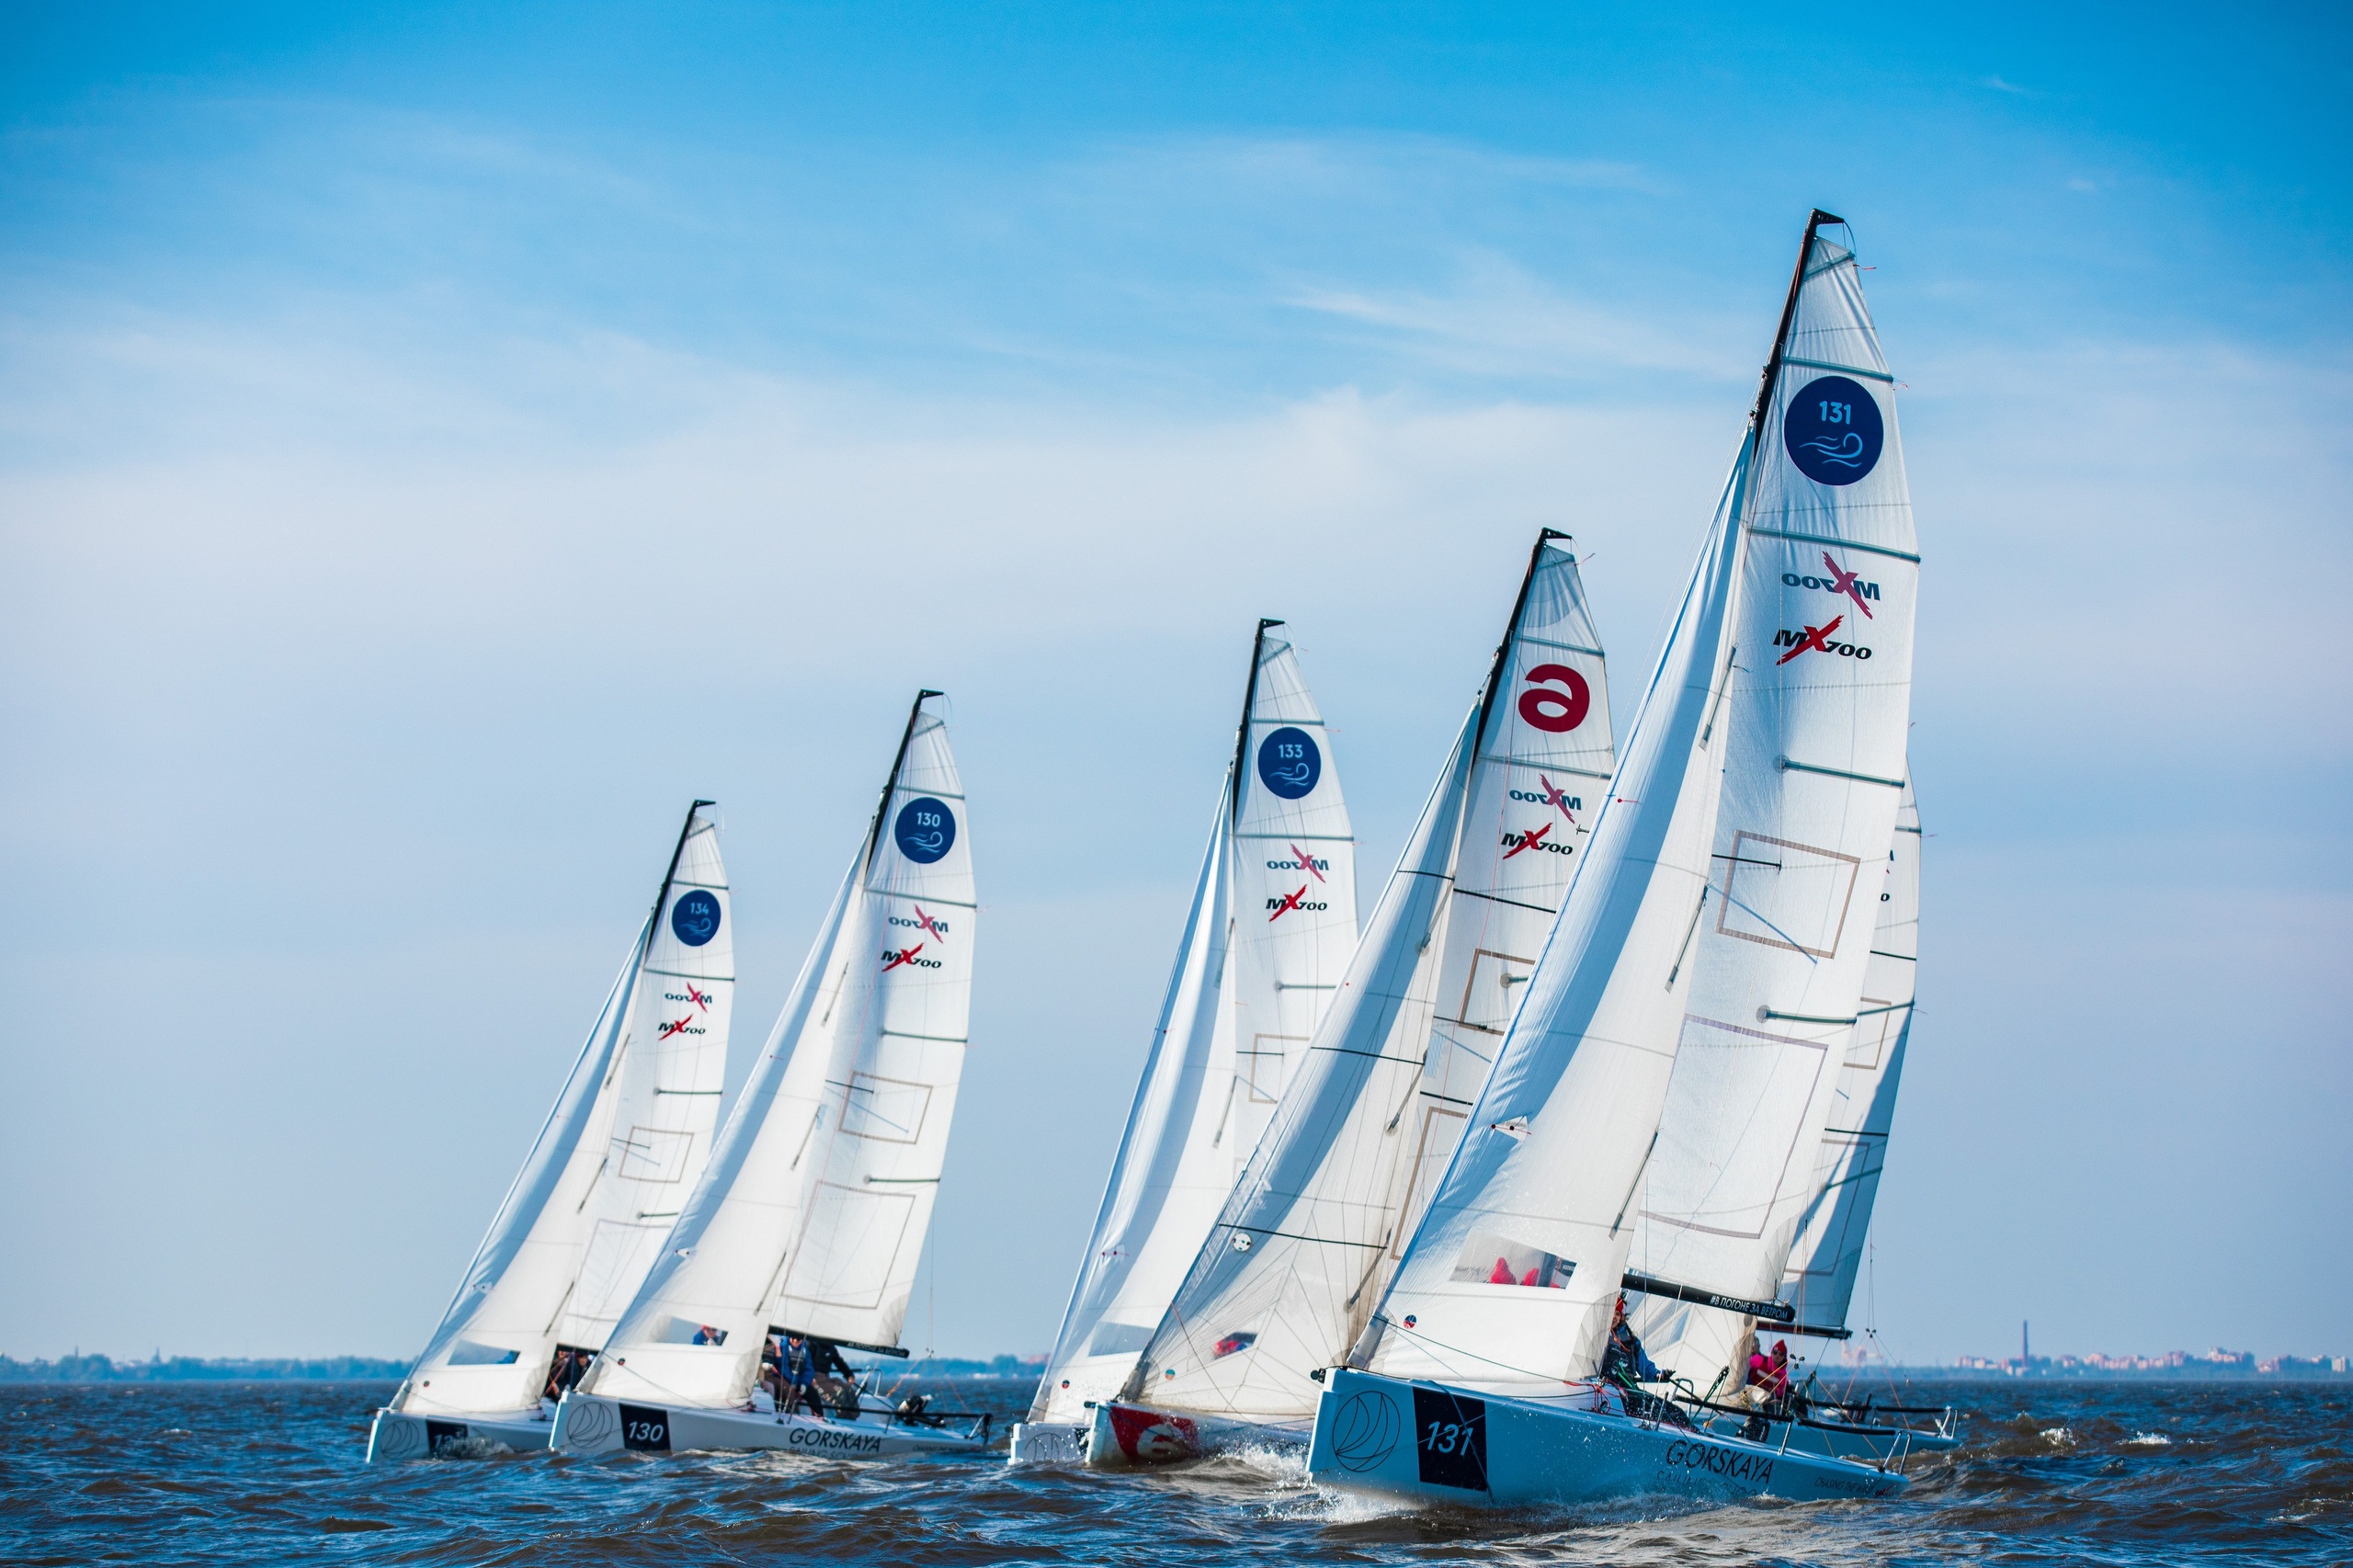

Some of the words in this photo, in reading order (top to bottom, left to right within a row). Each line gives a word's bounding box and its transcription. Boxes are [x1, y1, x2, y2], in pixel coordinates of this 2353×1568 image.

[1819, 400, 1851, 425] 131
[1773, 614, 1872, 665] MX700
[1278, 744, 1303, 758] 133
[916, 812, 940, 827] 130
[1501, 822, 1573, 859] MX700
[689, 902, 710, 915] 134
[1266, 884, 1327, 922] MX700
[881, 942, 942, 972] MX700
[658, 1014, 706, 1040] MX700
[1720, 1297, 1751, 1312] ПОГОНЕ
[1750, 1303, 1760, 1314] ЗА
[1760, 1305, 1790, 1320] ВЕТРОМ
[629, 1421, 665, 1442] 130
[790, 1427, 881, 1452] GORSKAYA
[1427, 1421, 1473, 1456] 131
[1666, 1439, 1774, 1484] GORSKAYA
[1814, 1477, 1846, 1491] CHASING
[1844, 1481, 1857, 1493] THE
